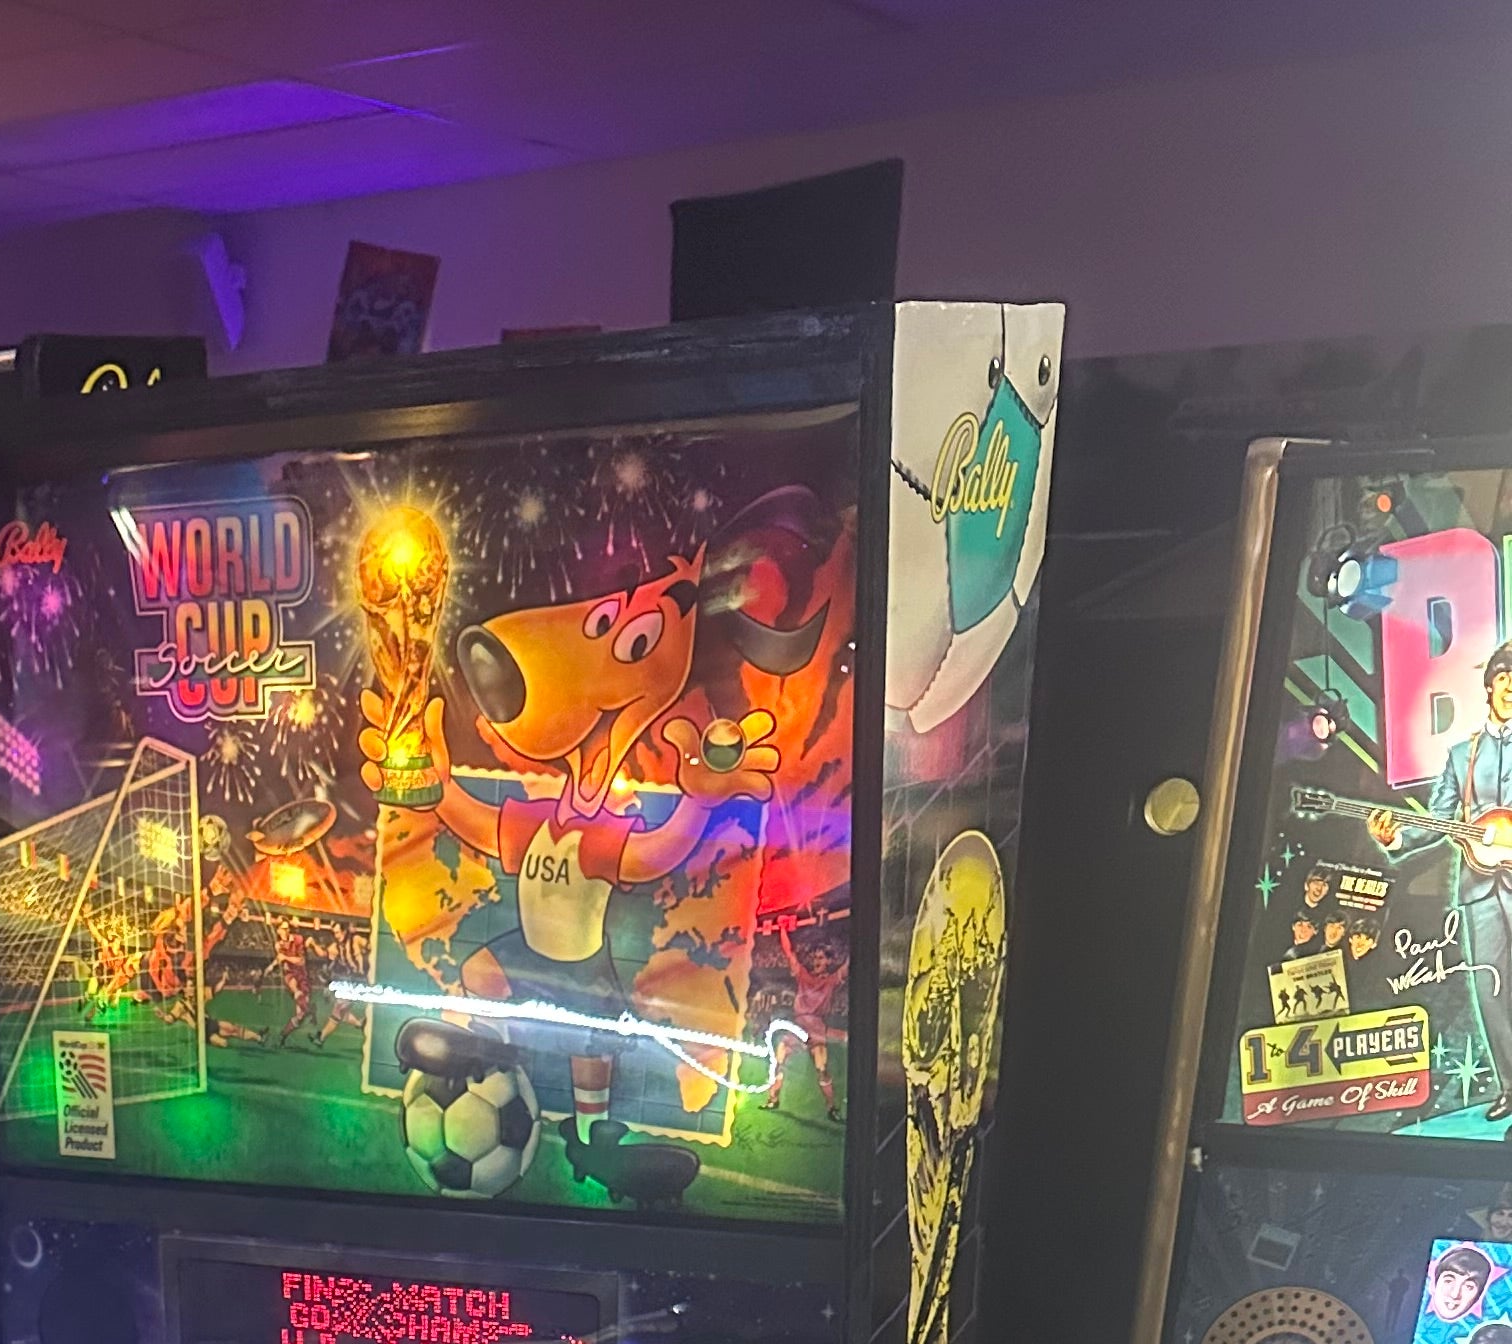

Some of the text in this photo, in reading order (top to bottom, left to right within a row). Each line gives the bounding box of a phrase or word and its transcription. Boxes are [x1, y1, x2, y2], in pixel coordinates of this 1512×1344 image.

[930, 411, 1016, 539] Bally
[139, 511, 301, 599] WORLD
[149, 642, 305, 689] Soccer
[174, 599, 272, 706] CUP
[524, 853, 571, 887] USA
[1394, 908, 1459, 959] Paul
[1245, 1024, 1420, 1085] 1 to 4 PLAYERS
[63, 1103, 100, 1120] Official
[1281, 1093, 1335, 1117] Game
[1339, 1082, 1374, 1113] Of
[1374, 1076, 1420, 1101] Skill
[64, 1120, 109, 1136] Licensed
[65, 1137, 104, 1152] Product
